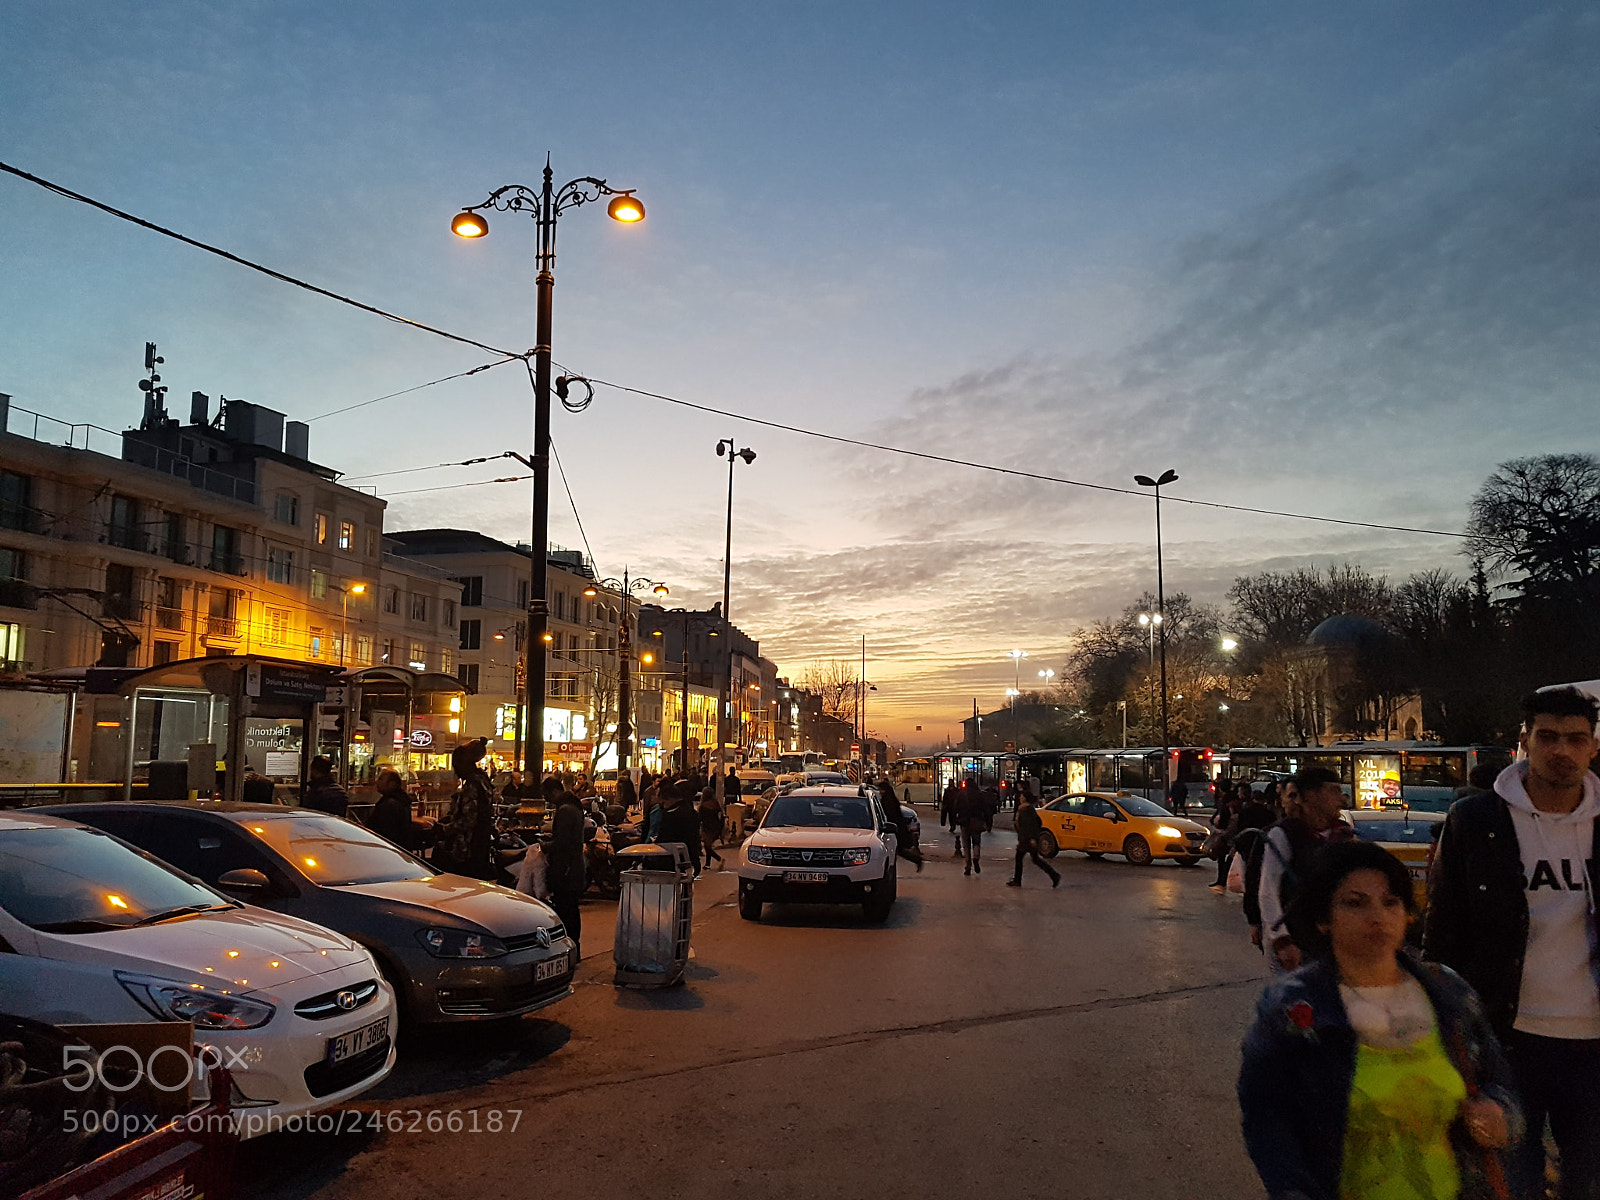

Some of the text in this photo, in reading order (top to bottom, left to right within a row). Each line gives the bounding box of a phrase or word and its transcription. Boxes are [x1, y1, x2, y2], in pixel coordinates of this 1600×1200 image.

[1359, 759, 1377, 769] YIL
[1519, 858, 1593, 891] AL
[335, 1037, 349, 1060] 34
